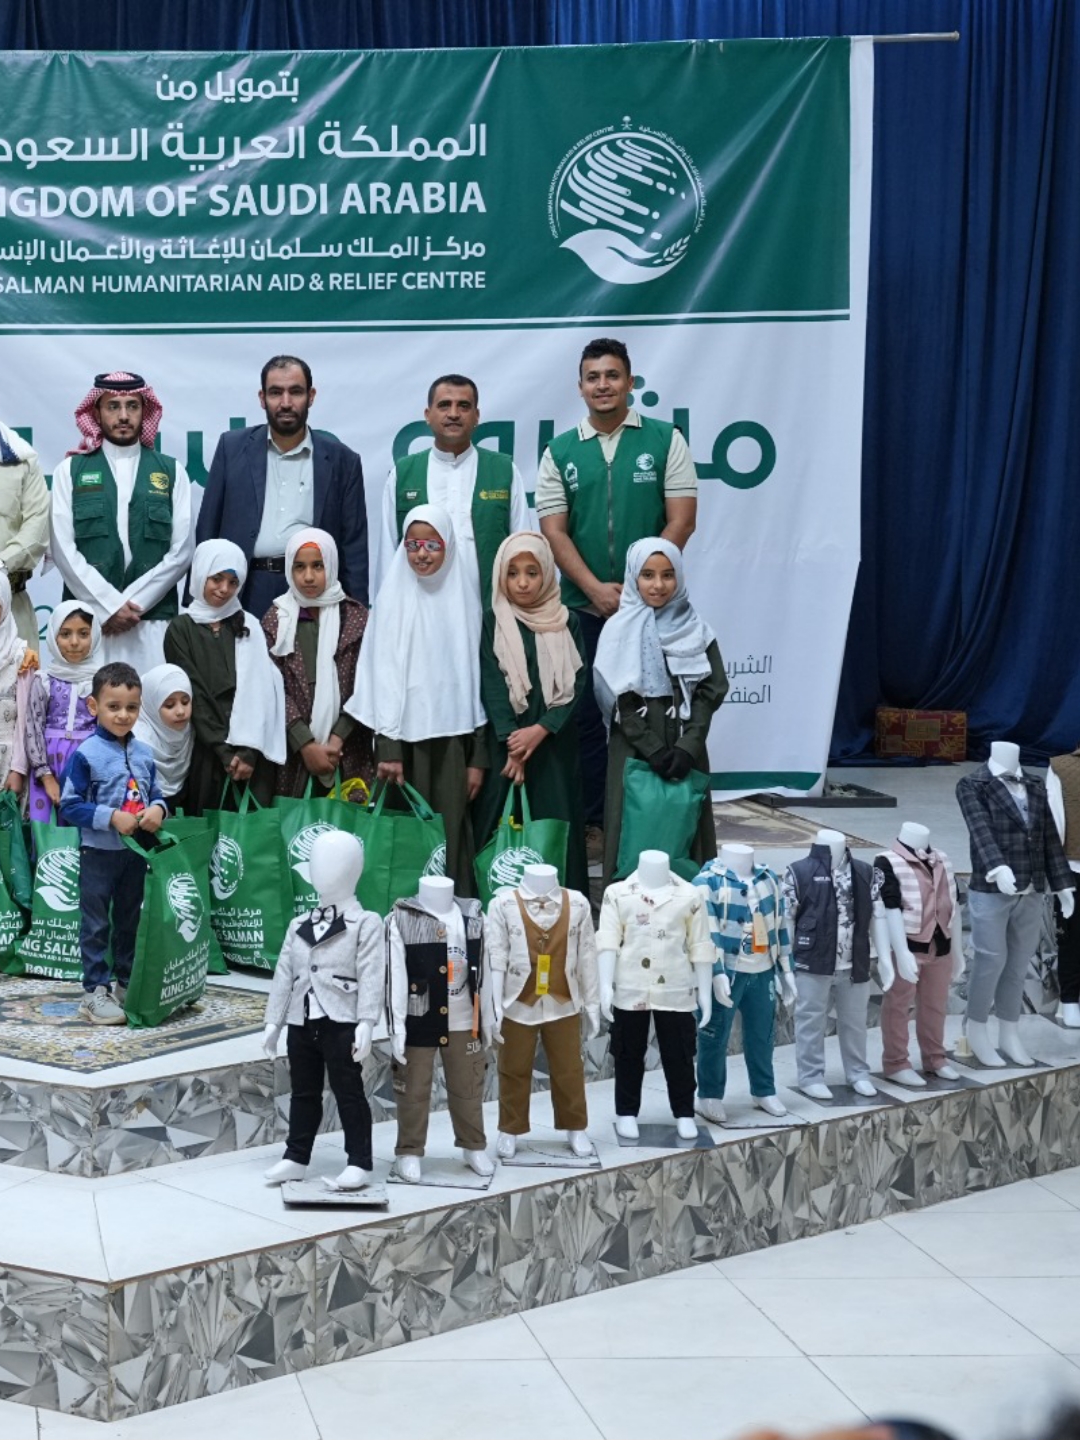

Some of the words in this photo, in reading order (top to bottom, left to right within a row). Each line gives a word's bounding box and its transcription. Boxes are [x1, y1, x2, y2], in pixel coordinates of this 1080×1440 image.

[156, 74, 198, 101] من
[205, 71, 299, 103] بتمويل
[161, 122, 306, 171] العربية
[318, 121, 487, 161] المملكة
[145, 185, 198, 217] OF
[208, 183, 329, 217] SAUDI
[339, 182, 487, 215] ARABIA
[50, 236, 155, 264] والأعمال
[160, 237, 246, 264] للإغاثة
[251, 237, 343, 261] سلمان
[347, 236, 419, 260] الملك
[422, 235, 486, 261] مركز
[92, 274, 262, 293] HUMANITARIAN
[268, 273, 305, 291] AID
[308, 273, 324, 291] &
[329, 272, 398, 290] RELIEF
[402, 271, 486, 289] CENTRE
[723, 684, 771, 704] المنف
[223, 930, 264, 943] SALMAN
